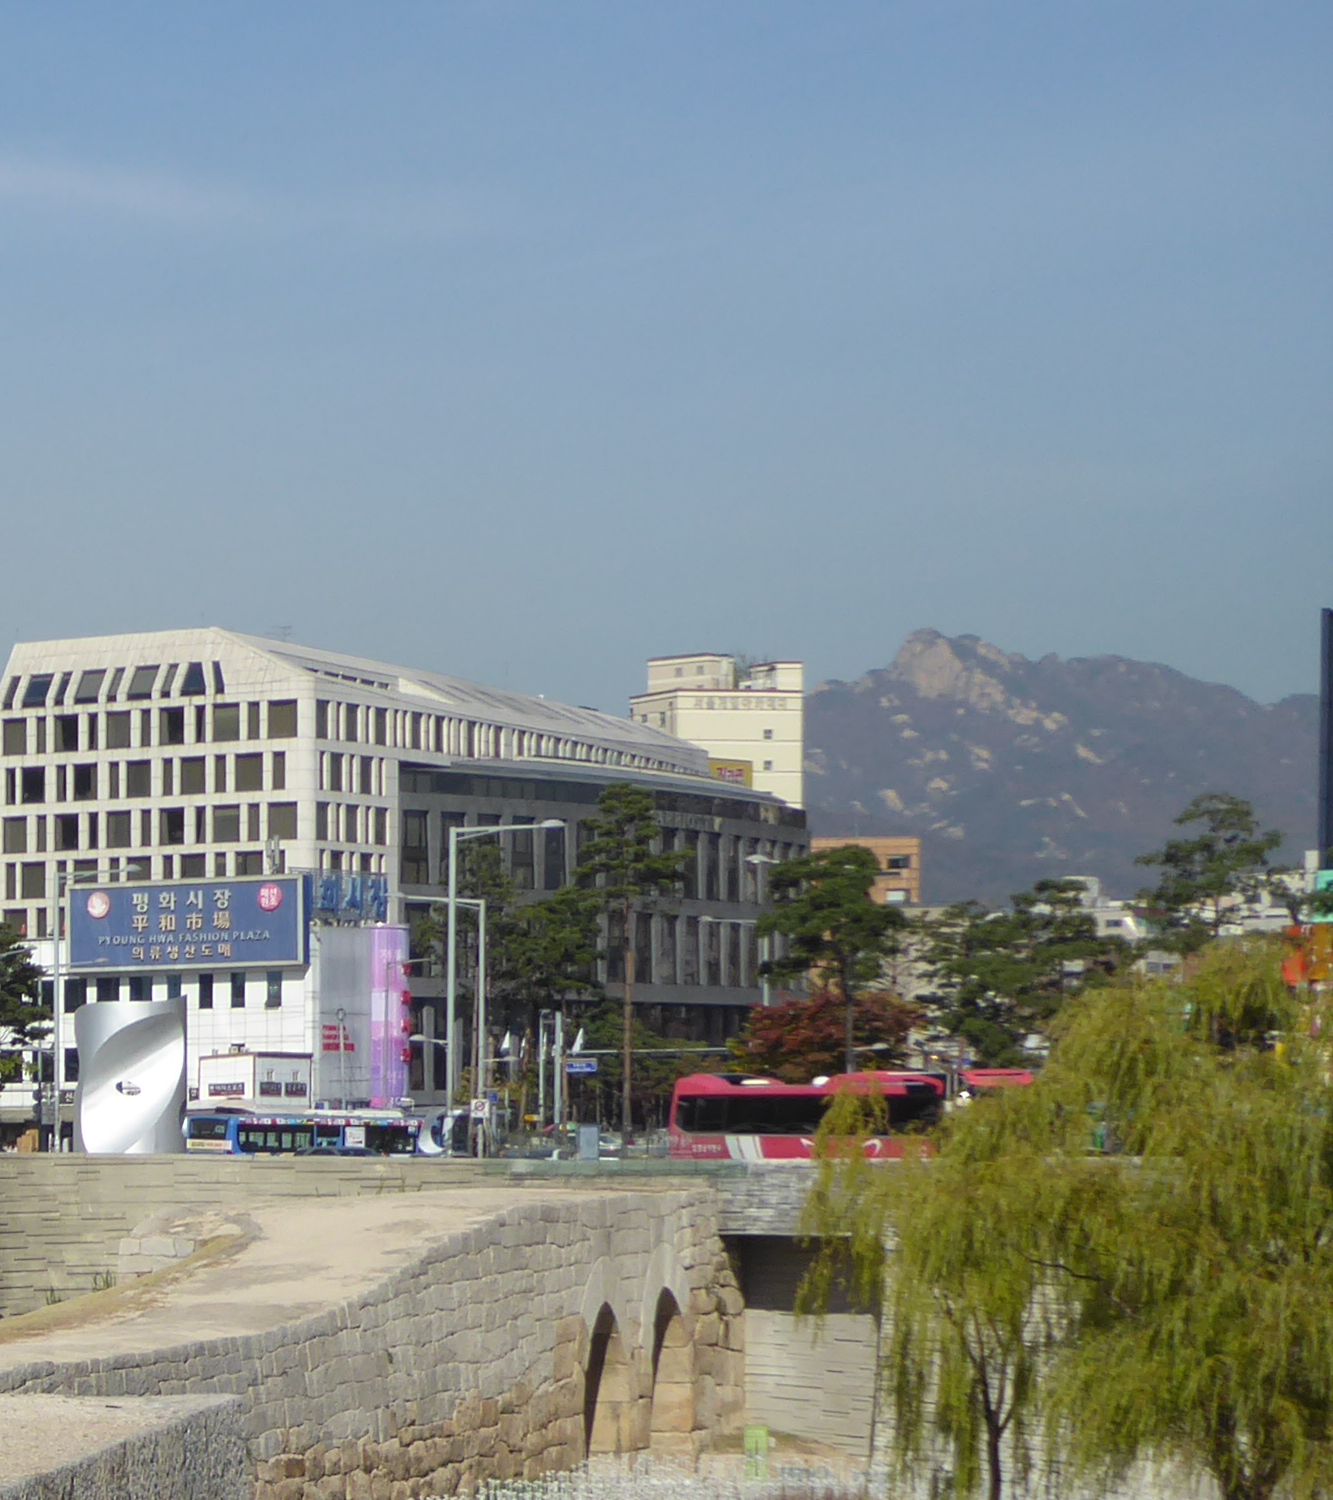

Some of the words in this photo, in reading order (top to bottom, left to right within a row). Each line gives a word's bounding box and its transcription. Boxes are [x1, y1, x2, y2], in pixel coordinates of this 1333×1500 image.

[132, 889, 231, 912] 평화시장
[132, 911, 231, 933] 平和市場
[98, 935, 145, 946] PYOUNG
[149, 933, 174, 944] HWA
[179, 931, 228, 942] FASHION
[233, 929, 271, 941] PLAZA
